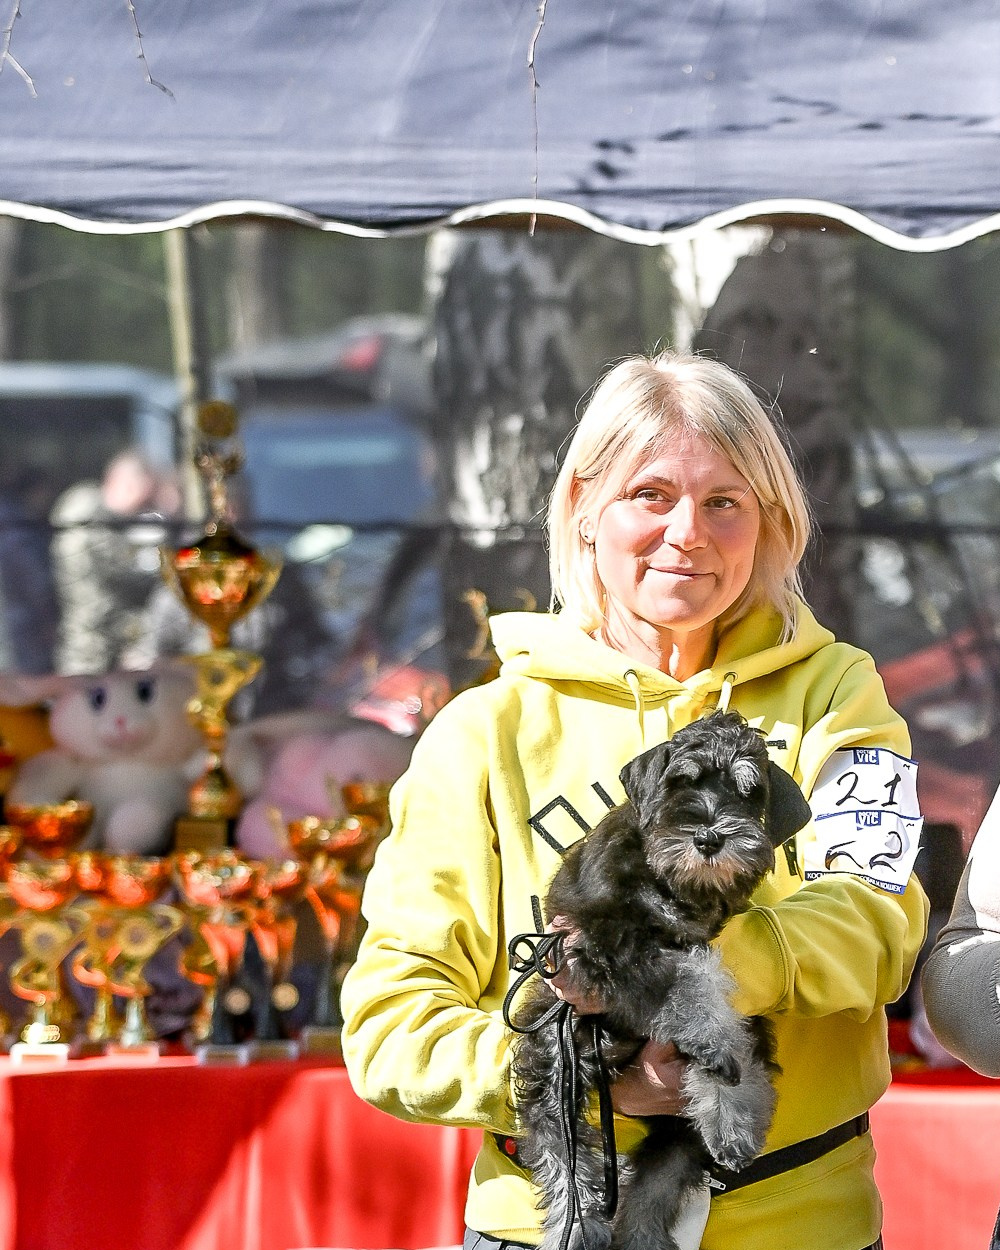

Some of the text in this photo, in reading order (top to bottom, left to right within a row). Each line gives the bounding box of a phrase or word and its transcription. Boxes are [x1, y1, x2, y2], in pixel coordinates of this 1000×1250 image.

[857, 752, 877, 764] VIC
[836, 771, 902, 807] 21
[858, 815, 879, 826] VIC
